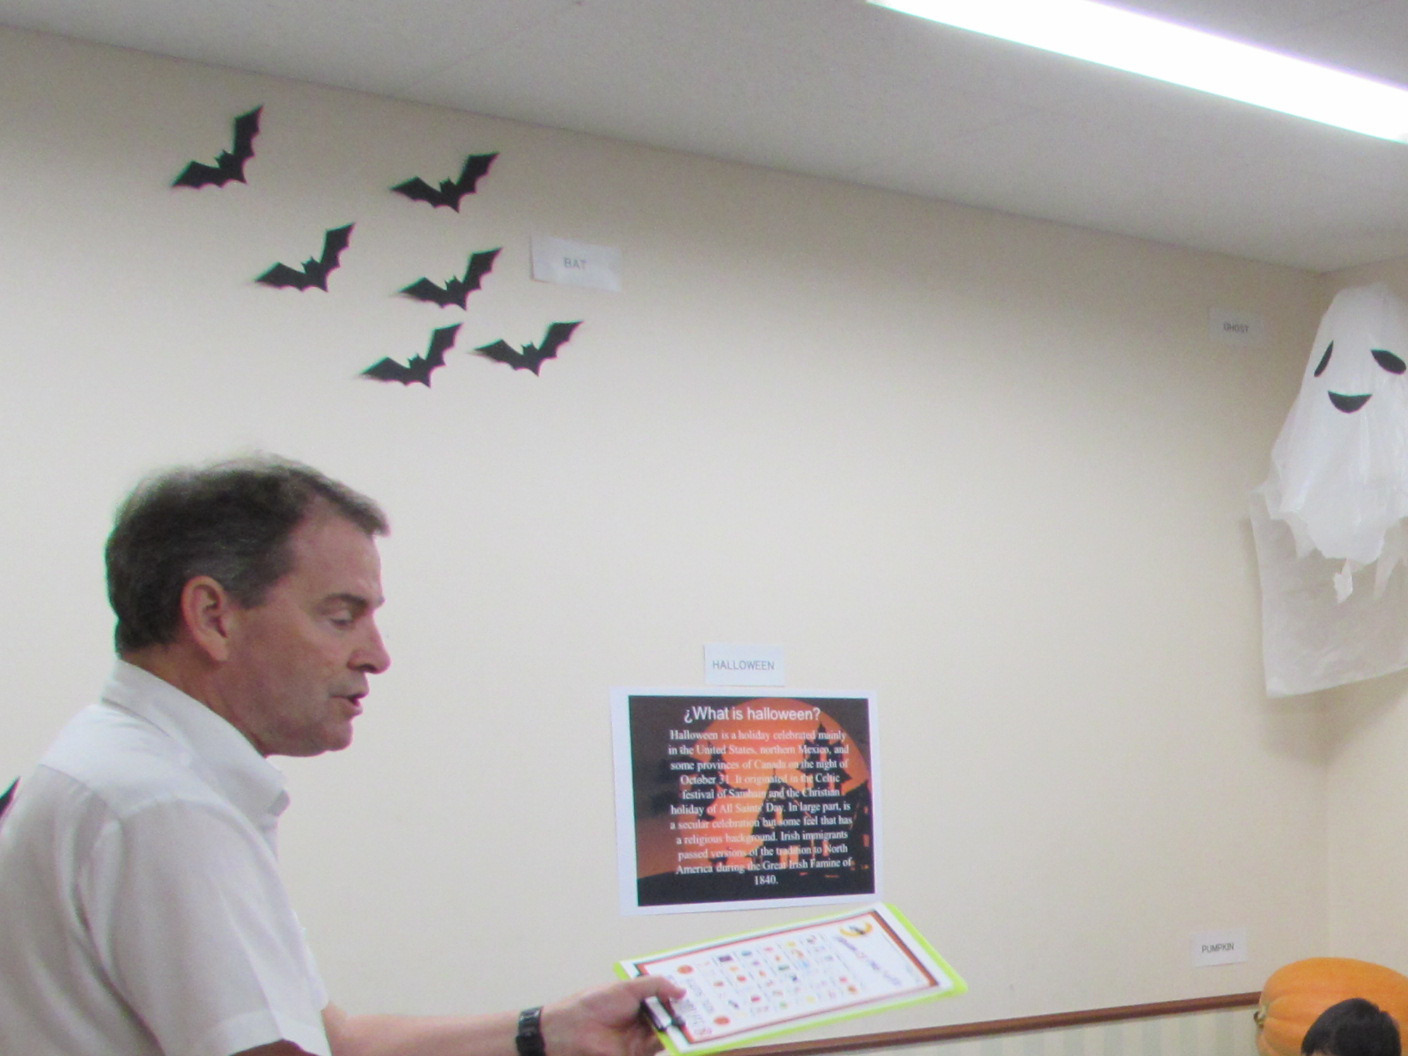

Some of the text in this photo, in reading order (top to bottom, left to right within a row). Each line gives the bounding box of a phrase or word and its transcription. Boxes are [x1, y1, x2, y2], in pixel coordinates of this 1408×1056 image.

[564, 257, 587, 270] BAT
[712, 660, 775, 671] HALLOWEEN
[684, 706, 821, 723] ¿What is halloween?
[669, 729, 718, 740] Halloween
[739, 730, 769, 742] holiday
[668, 744, 678, 755] in
[679, 745, 694, 755] the
[833, 744, 849, 754] and
[670, 761, 695, 770] some
[801, 758, 814, 768] the
[816, 758, 837, 771] night
[680, 773, 716, 785] October
[815, 772, 841, 783] Celtic
[682, 788, 715, 799] festival
[769, 787, 784, 798] and
[786, 787, 800, 797] the
[802, 786, 840, 797] Christian
[670, 804, 705, 816] holiday
[800, 801, 821, 813] large
[843, 800, 851, 810] is
[678, 819, 709, 830] secular
[803, 815, 818, 826] feel
[821, 815, 837, 825] that
[838, 814, 853, 825] has
[781, 830, 800, 841] Irish
[802, 829, 848, 842] immigrants
[678, 848, 708, 862] passed
[760, 846, 774, 856] the
[675, 863, 713, 875] America
[810, 858, 841, 869] Famine
[754, 875, 779, 886] 1840.
